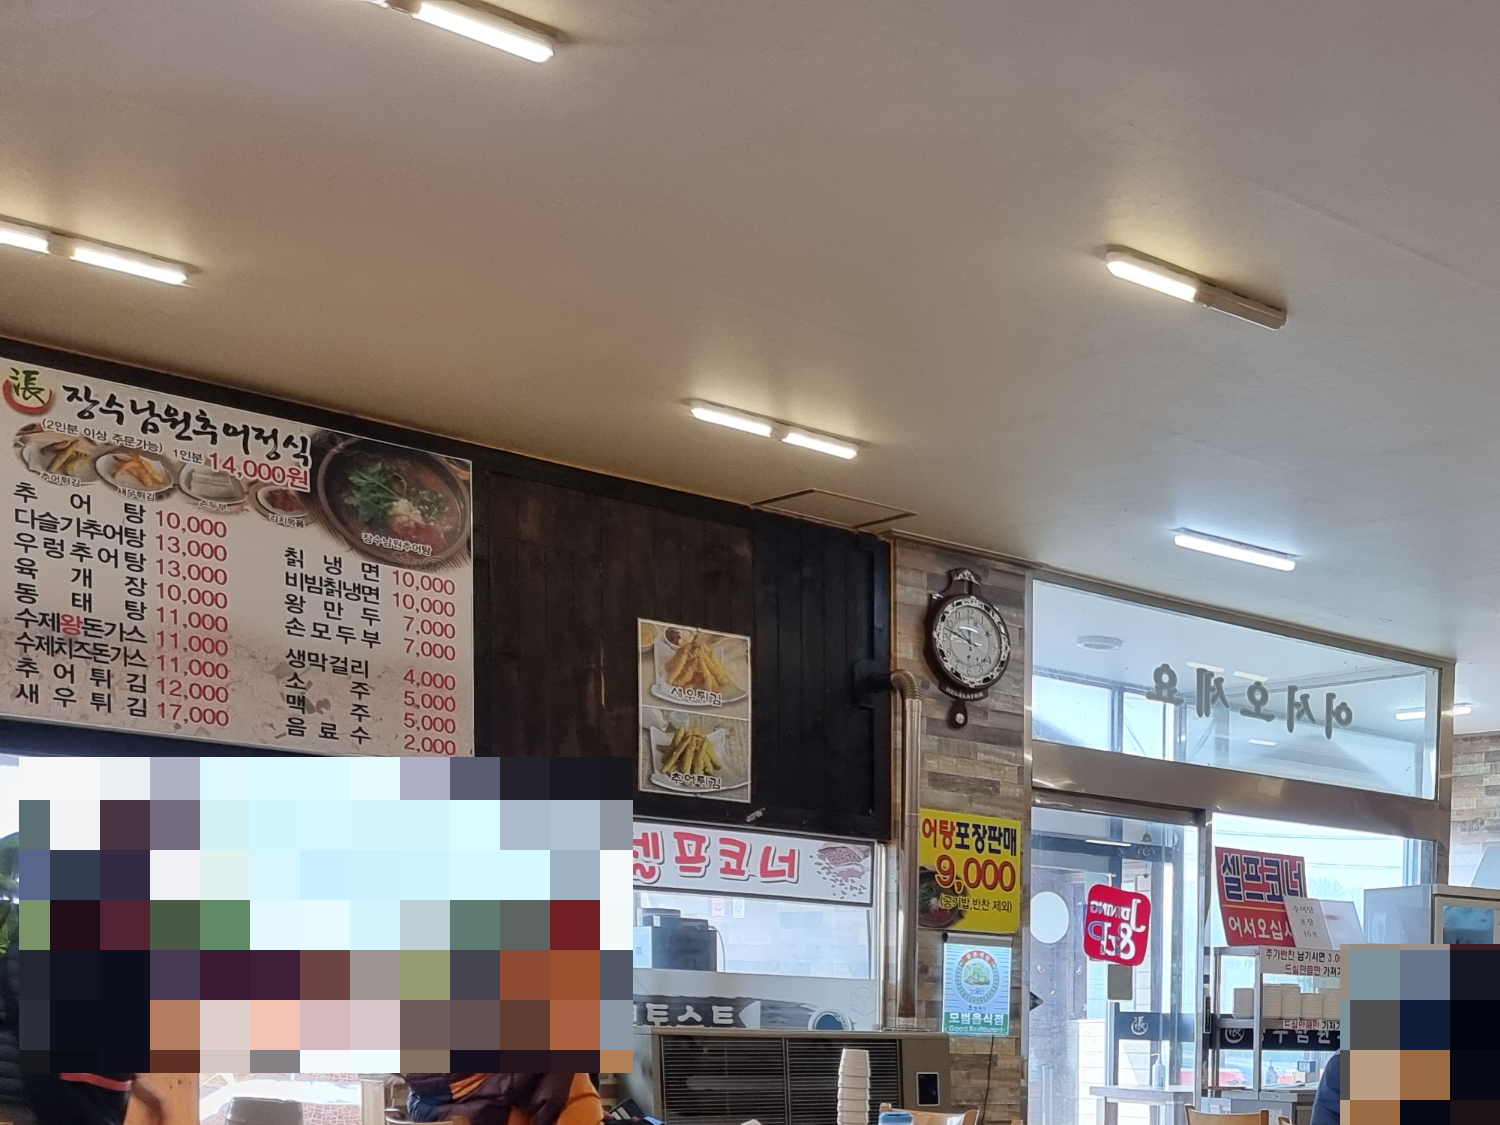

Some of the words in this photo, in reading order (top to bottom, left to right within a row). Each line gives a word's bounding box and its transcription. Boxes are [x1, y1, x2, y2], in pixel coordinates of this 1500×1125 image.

[62, 385, 311, 467] 장수남원추어정식
[83, 427, 107, 441] 이상
[112, 433, 163, 453] 주문가능)
[209, 453, 309, 491] 14,000원
[14, 508, 146, 549] 다슬기추어탕
[156, 534, 227, 562] 13,000
[156, 510, 227, 538] 10,000
[156, 558, 228, 585] 13,000
[393, 569, 456, 595] 10,000
[156, 582, 228, 609] 10,000
[285, 571, 380, 605] 비빔칡냉면
[393, 592, 456, 617] 10,000
[14, 608, 148, 644] 수제왕돈가스
[156, 630, 229, 655] 11,000
[156, 606, 228, 632] 11,000
[403, 615, 456, 639] 7,000
[15, 631, 148, 668] 수제치즈돈가스
[157, 654, 229, 679] 11,000
[403, 637, 456, 661] 7,000
[285, 648, 369, 679] 생막걸리
[403, 668, 456, 691] 4,000
[157, 678, 229, 703] 12,000
[403, 690, 456, 712] 5,000
[157, 702, 230, 727] 17,000
[403, 712, 456, 734] 5,000
[403, 734, 456, 755] 2,000
[935, 854, 1017, 894] 9,000
[1221, 852, 1304, 902] 셀프코너
[633, 1003, 734, 1027] 토스트
[948, 1012, 1005, 1026] 모범음식점
